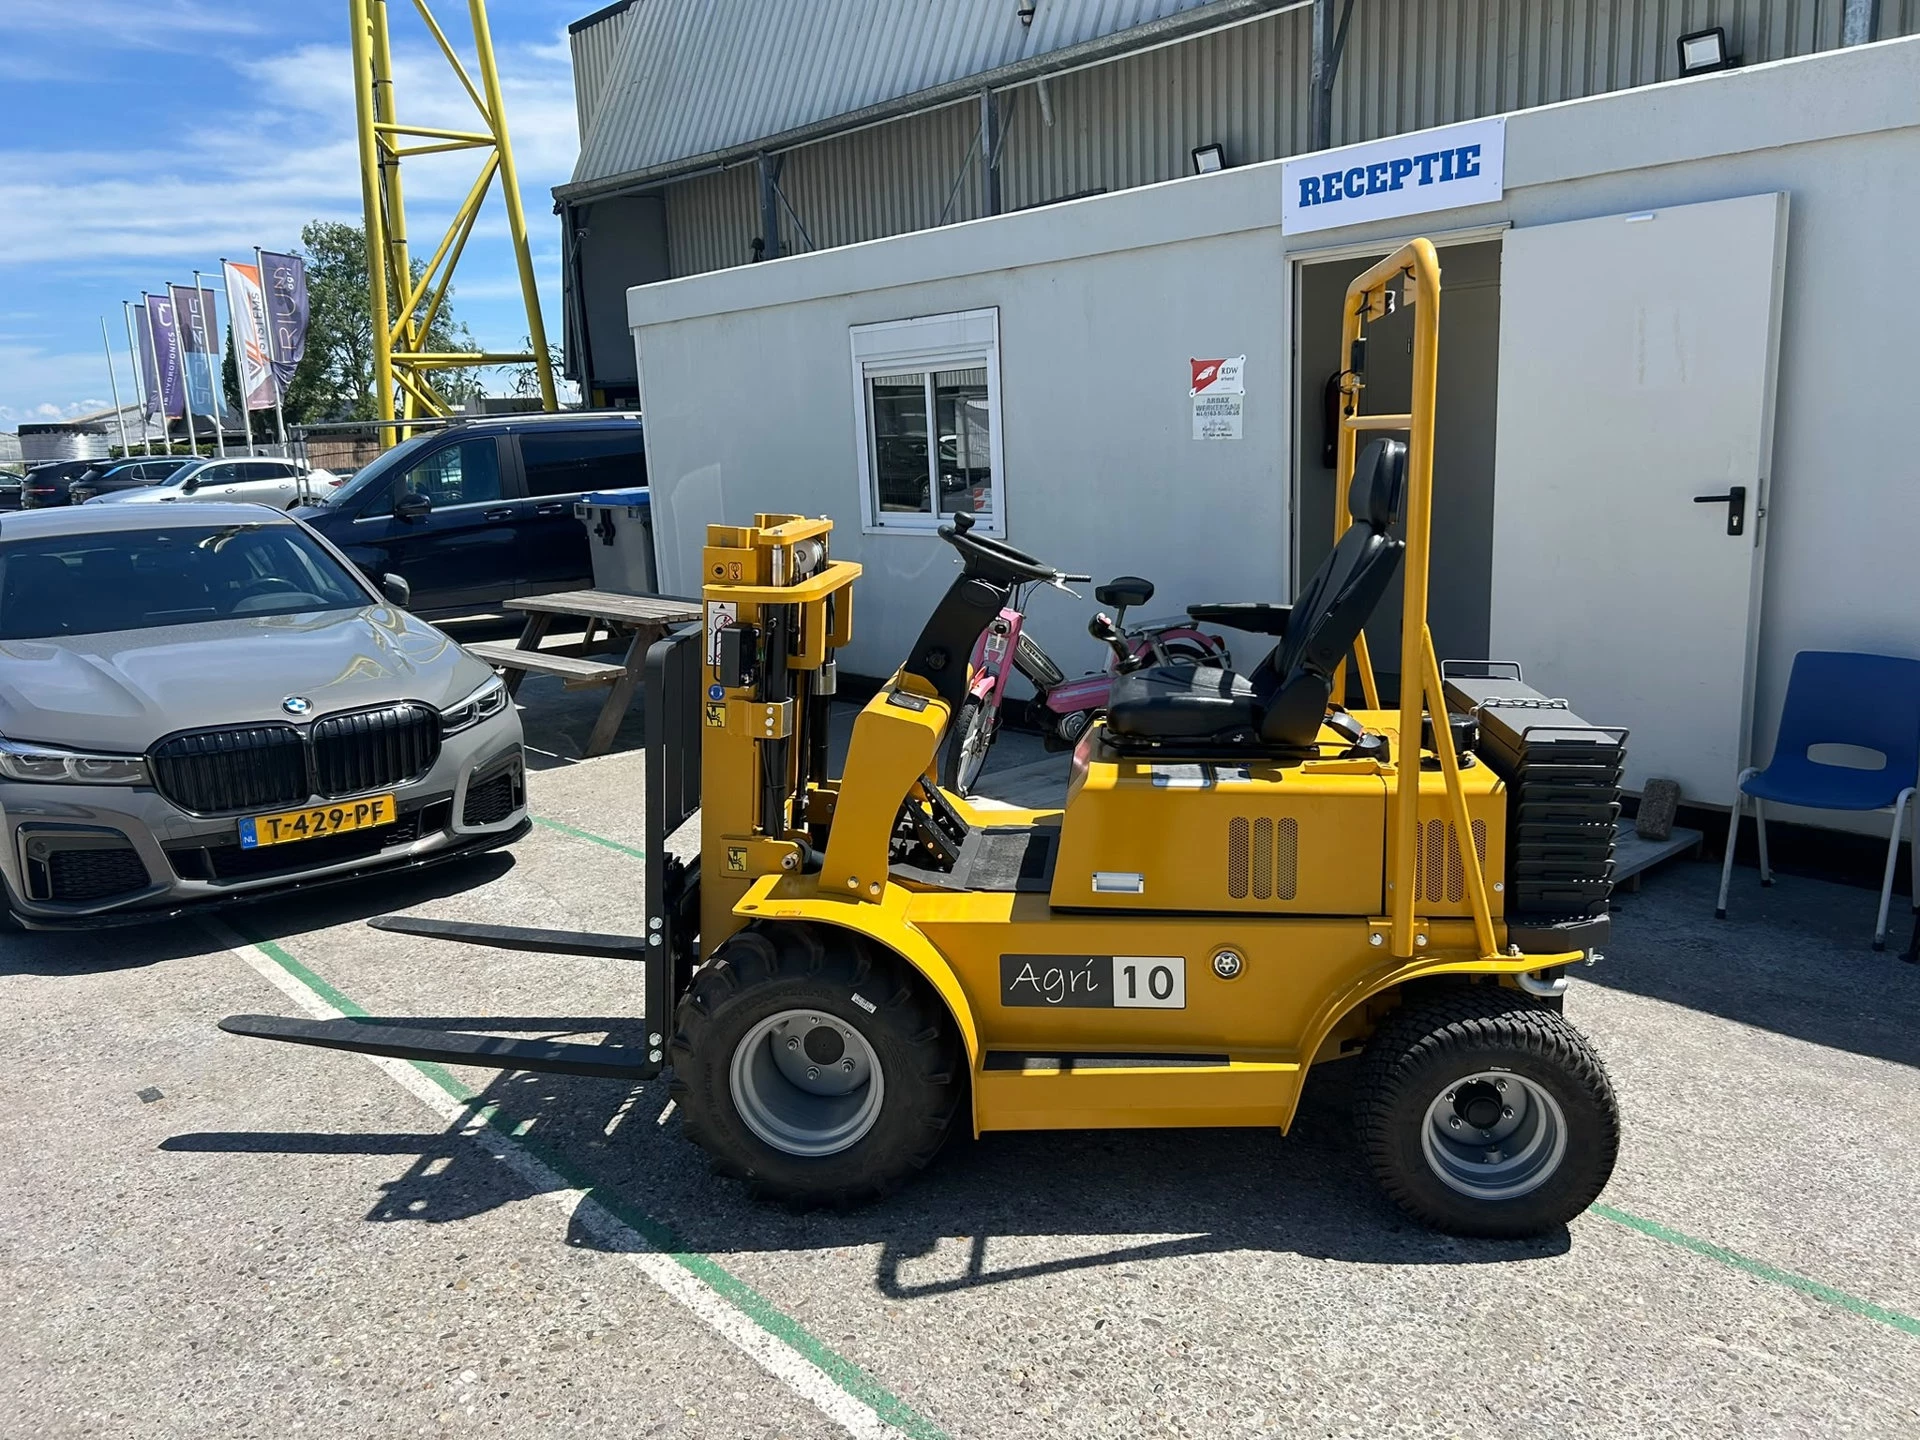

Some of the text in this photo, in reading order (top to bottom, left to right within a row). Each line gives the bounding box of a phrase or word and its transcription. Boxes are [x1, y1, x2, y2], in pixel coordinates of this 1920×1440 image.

[1299, 143, 1481, 208] RECEPTIE
[1221, 367, 1239, 375] RDW
[266, 800, 384, 839] T-429-PF
[1009, 958, 1174, 1003] Agri 10
